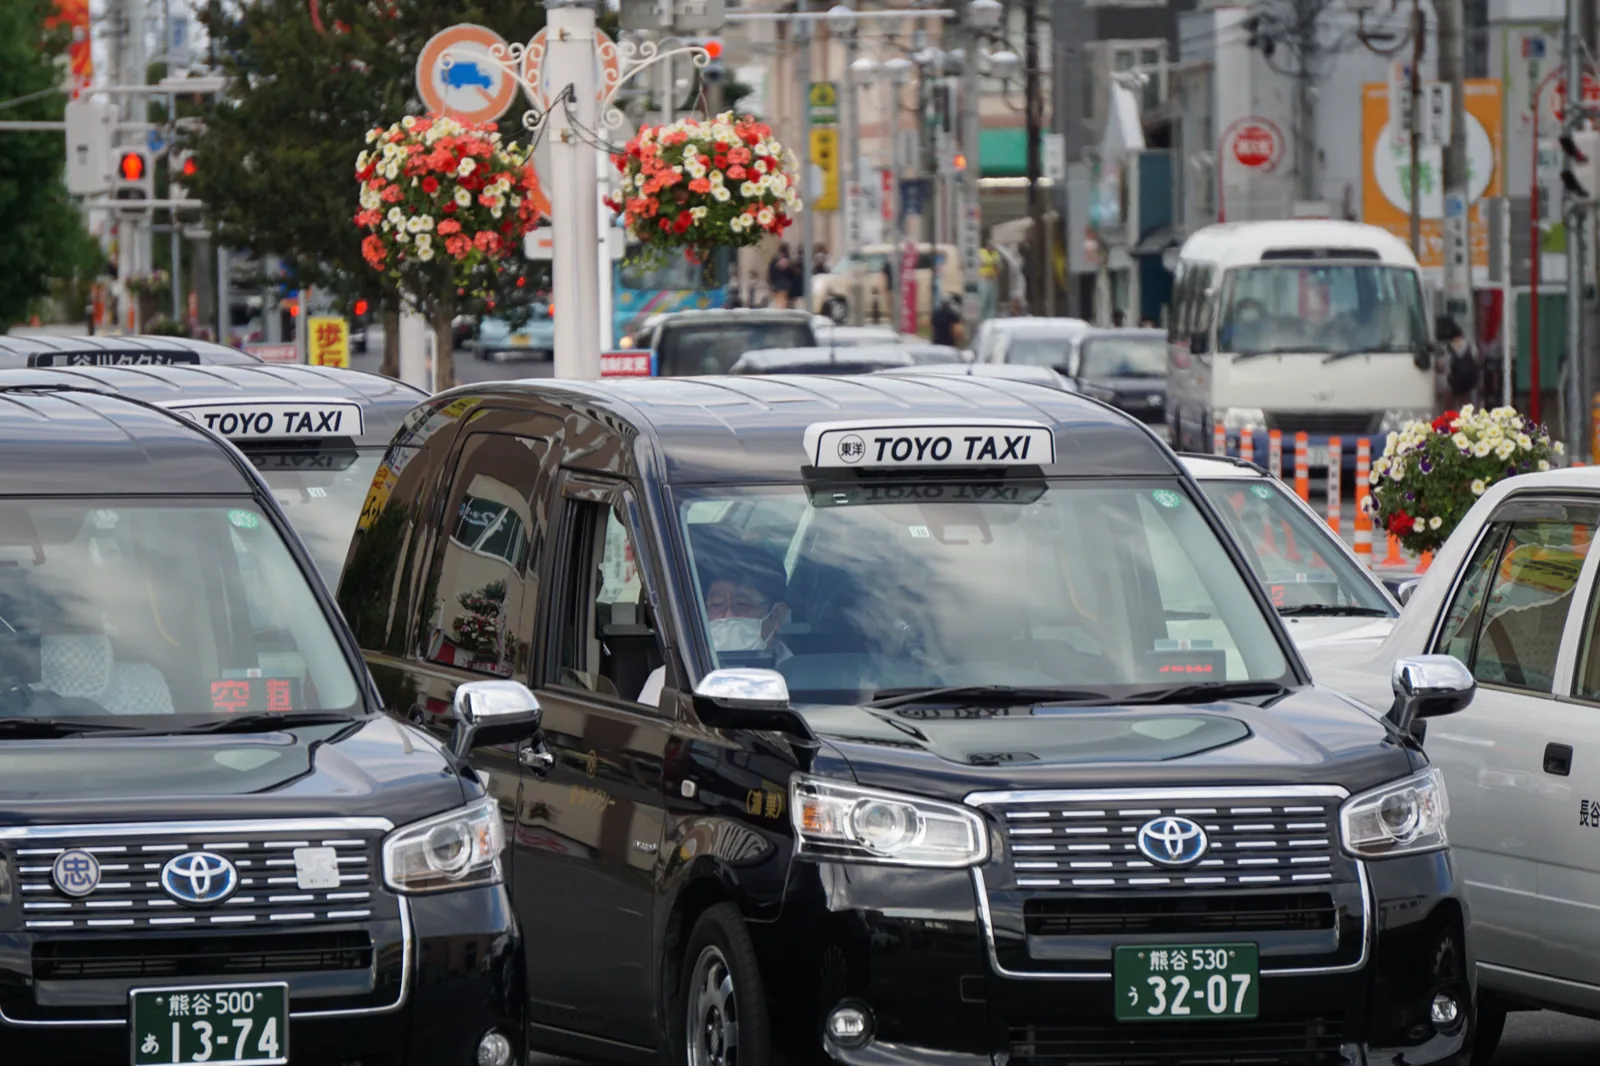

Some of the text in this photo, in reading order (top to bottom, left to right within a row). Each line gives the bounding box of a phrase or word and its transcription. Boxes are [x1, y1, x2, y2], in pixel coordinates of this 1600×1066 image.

[203, 411, 342, 434] TOYO TAXI
[840, 441, 864, 457] 東洋
[874, 436, 1031, 461] TOYO TAXI
[62, 857, 92, 886] 忠
[1150, 949, 1228, 971] 熊谷 530
[168, 991, 254, 1016] 熊谷 500
[1128, 974, 1251, 1015] う 32-07
[140, 1017, 279, 1063] あ 13-74
